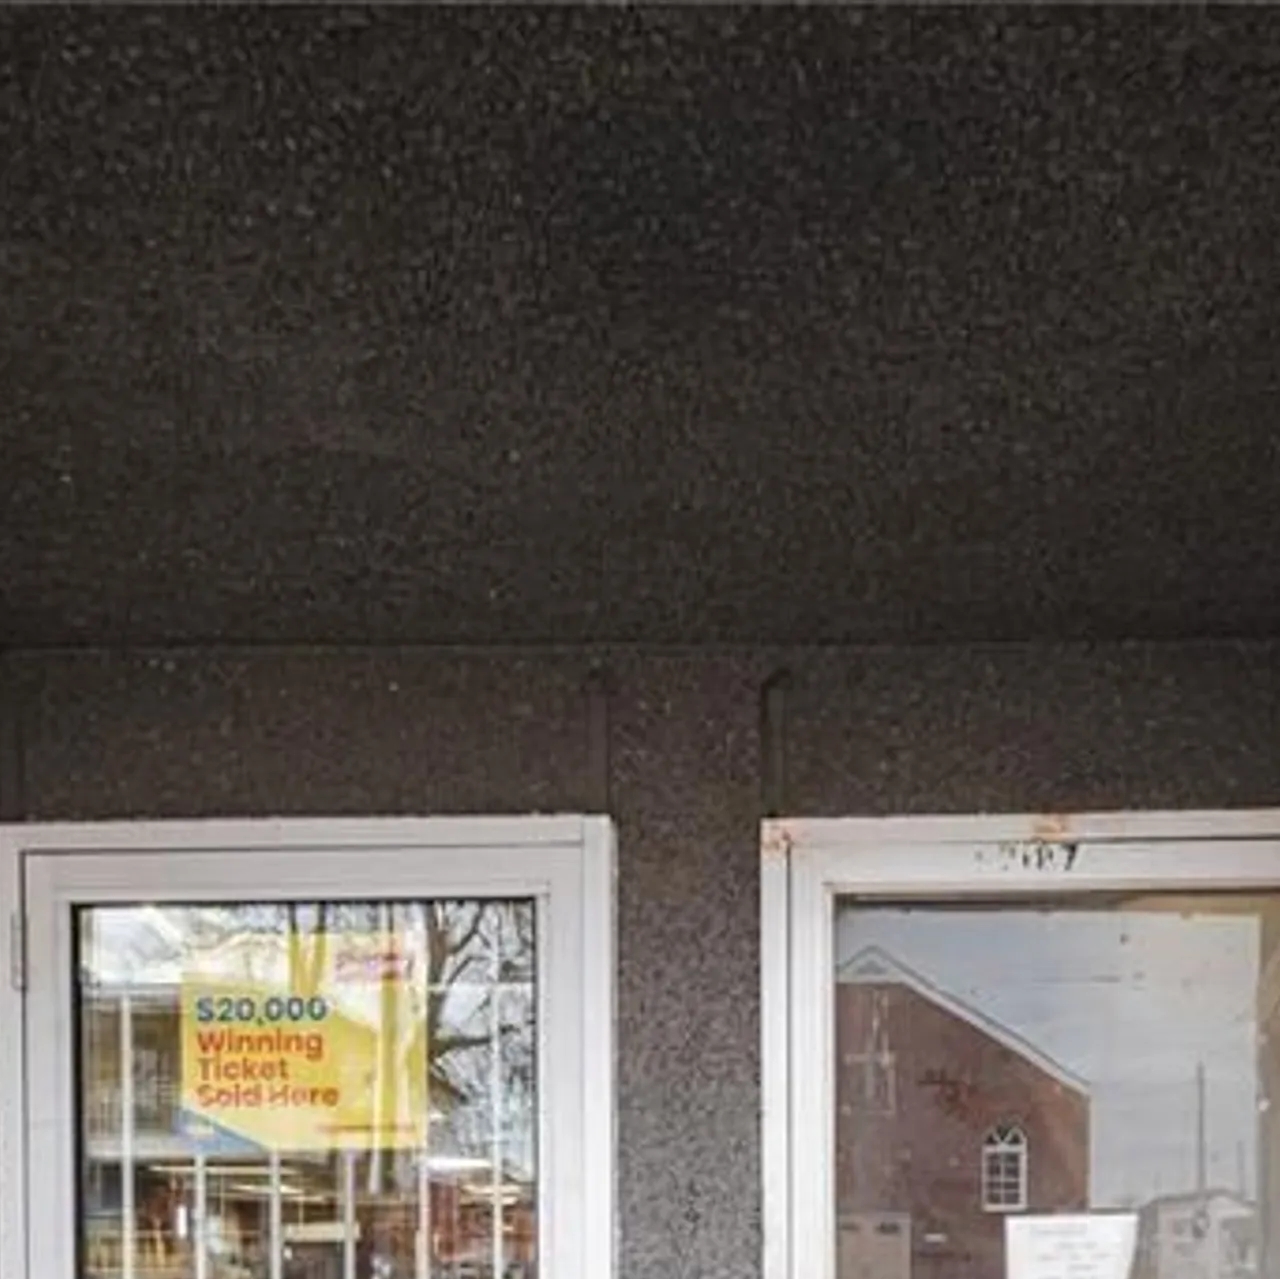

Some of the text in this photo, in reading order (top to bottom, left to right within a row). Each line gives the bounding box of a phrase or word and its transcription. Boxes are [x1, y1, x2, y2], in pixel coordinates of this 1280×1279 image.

[196, 996, 328, 1027] $20,000
[197, 1029, 324, 1062] Winning
[198, 1057, 290, 1081] Ticket
[197, 1084, 340, 1107] Sold Here
